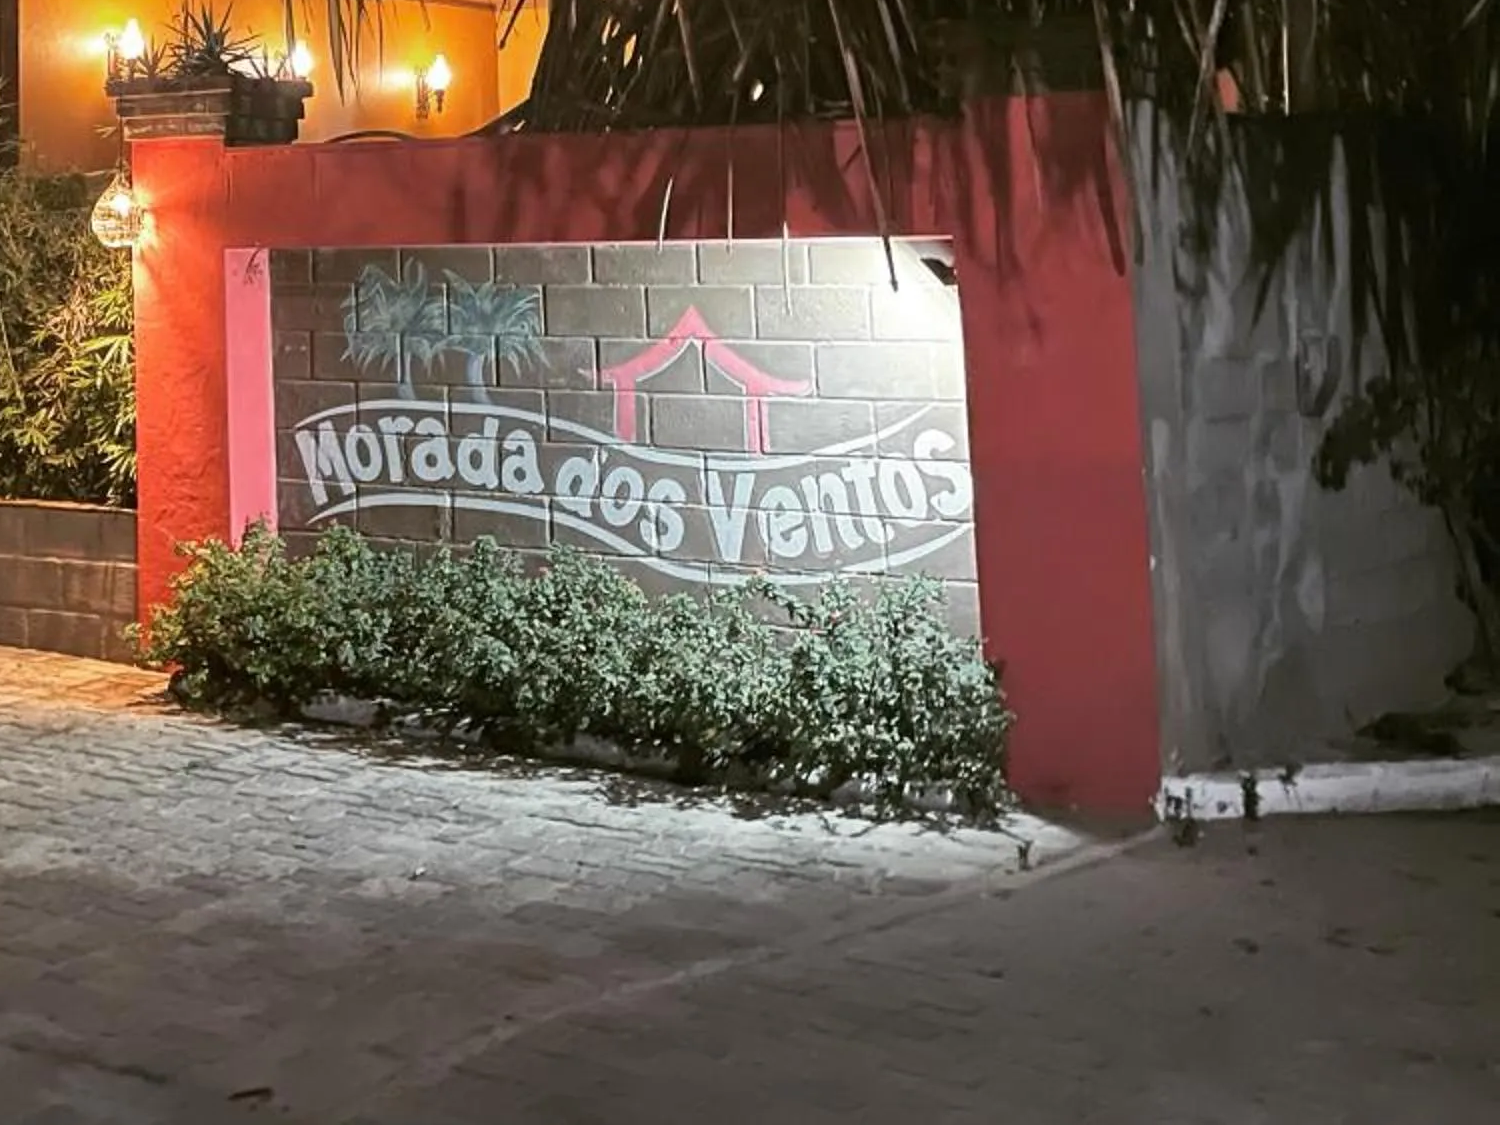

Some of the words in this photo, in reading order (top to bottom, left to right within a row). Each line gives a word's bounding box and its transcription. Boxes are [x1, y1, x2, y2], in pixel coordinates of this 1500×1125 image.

[296, 416, 544, 505] Morada
[556, 448, 685, 552] dos
[706, 429, 973, 561] Ventos
